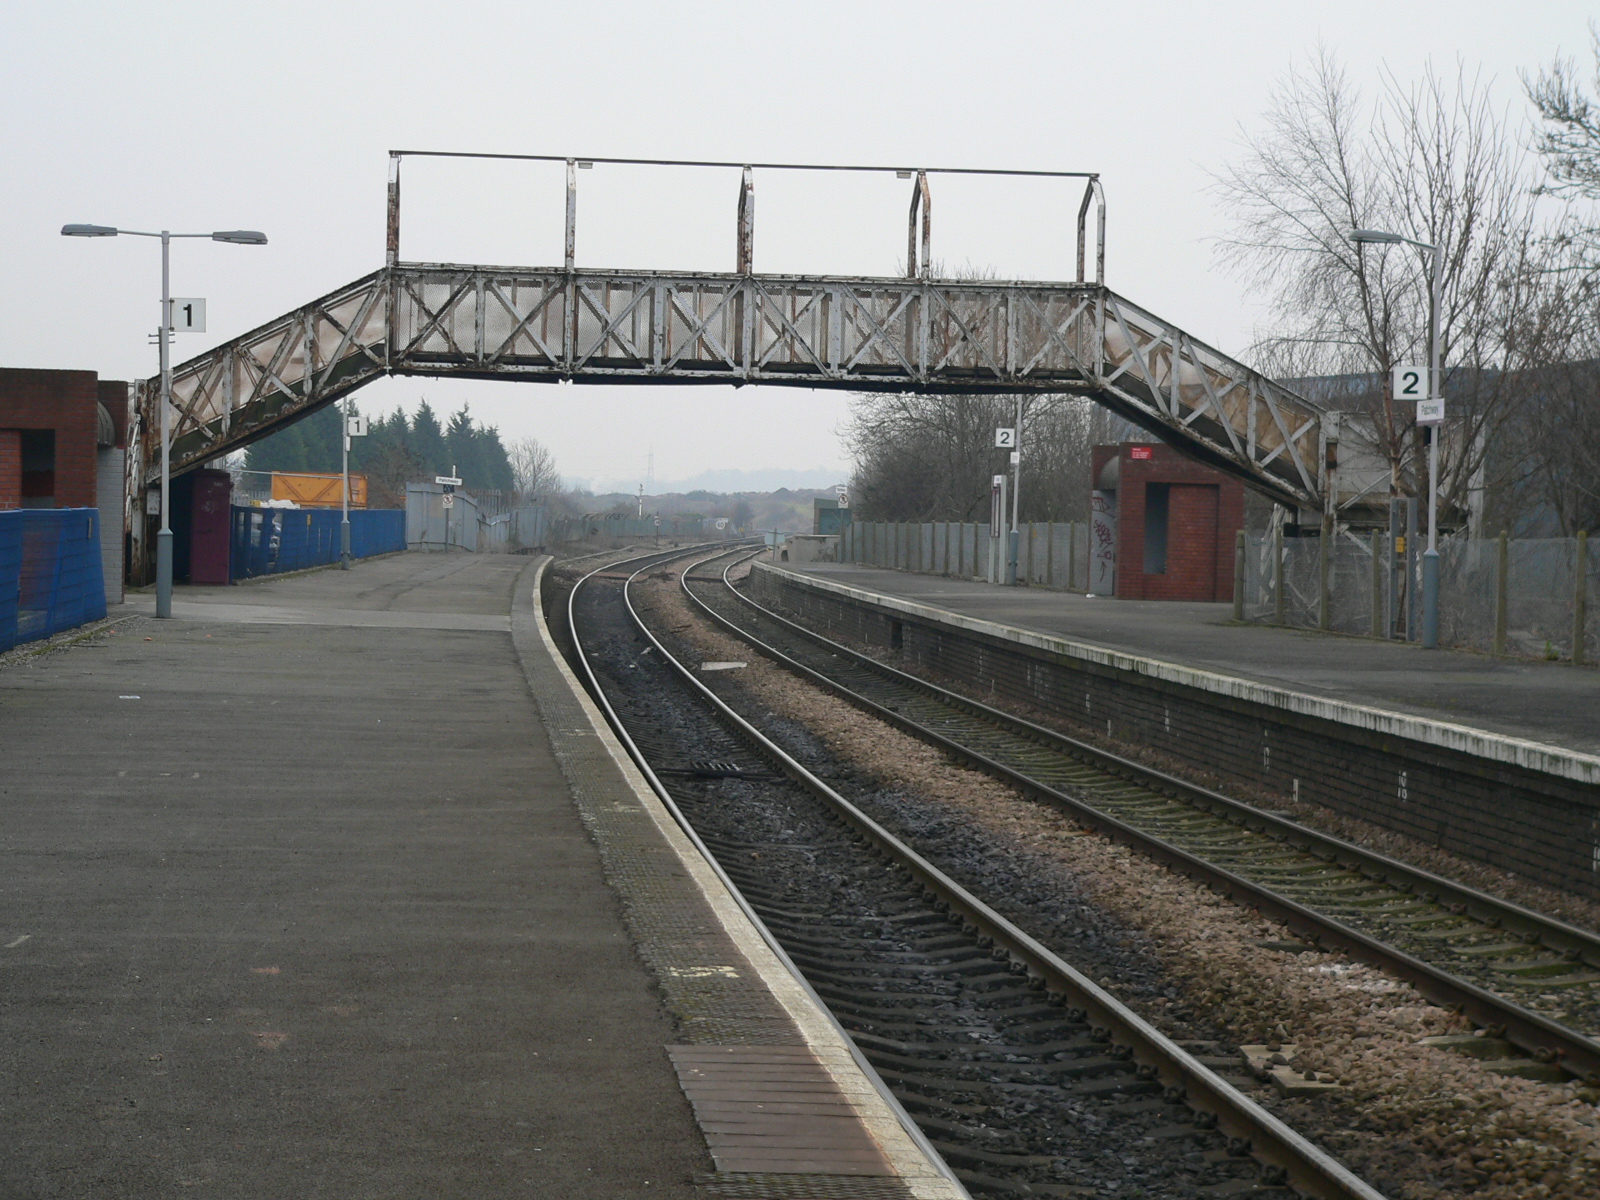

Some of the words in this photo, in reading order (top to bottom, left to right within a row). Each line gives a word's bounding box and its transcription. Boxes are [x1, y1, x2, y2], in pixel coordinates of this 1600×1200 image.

[183, 303, 192, 327] 1
[1402, 371, 1419, 394] 2
[354, 420, 360, 433] 1
[1000, 431, 1010, 444] 2
